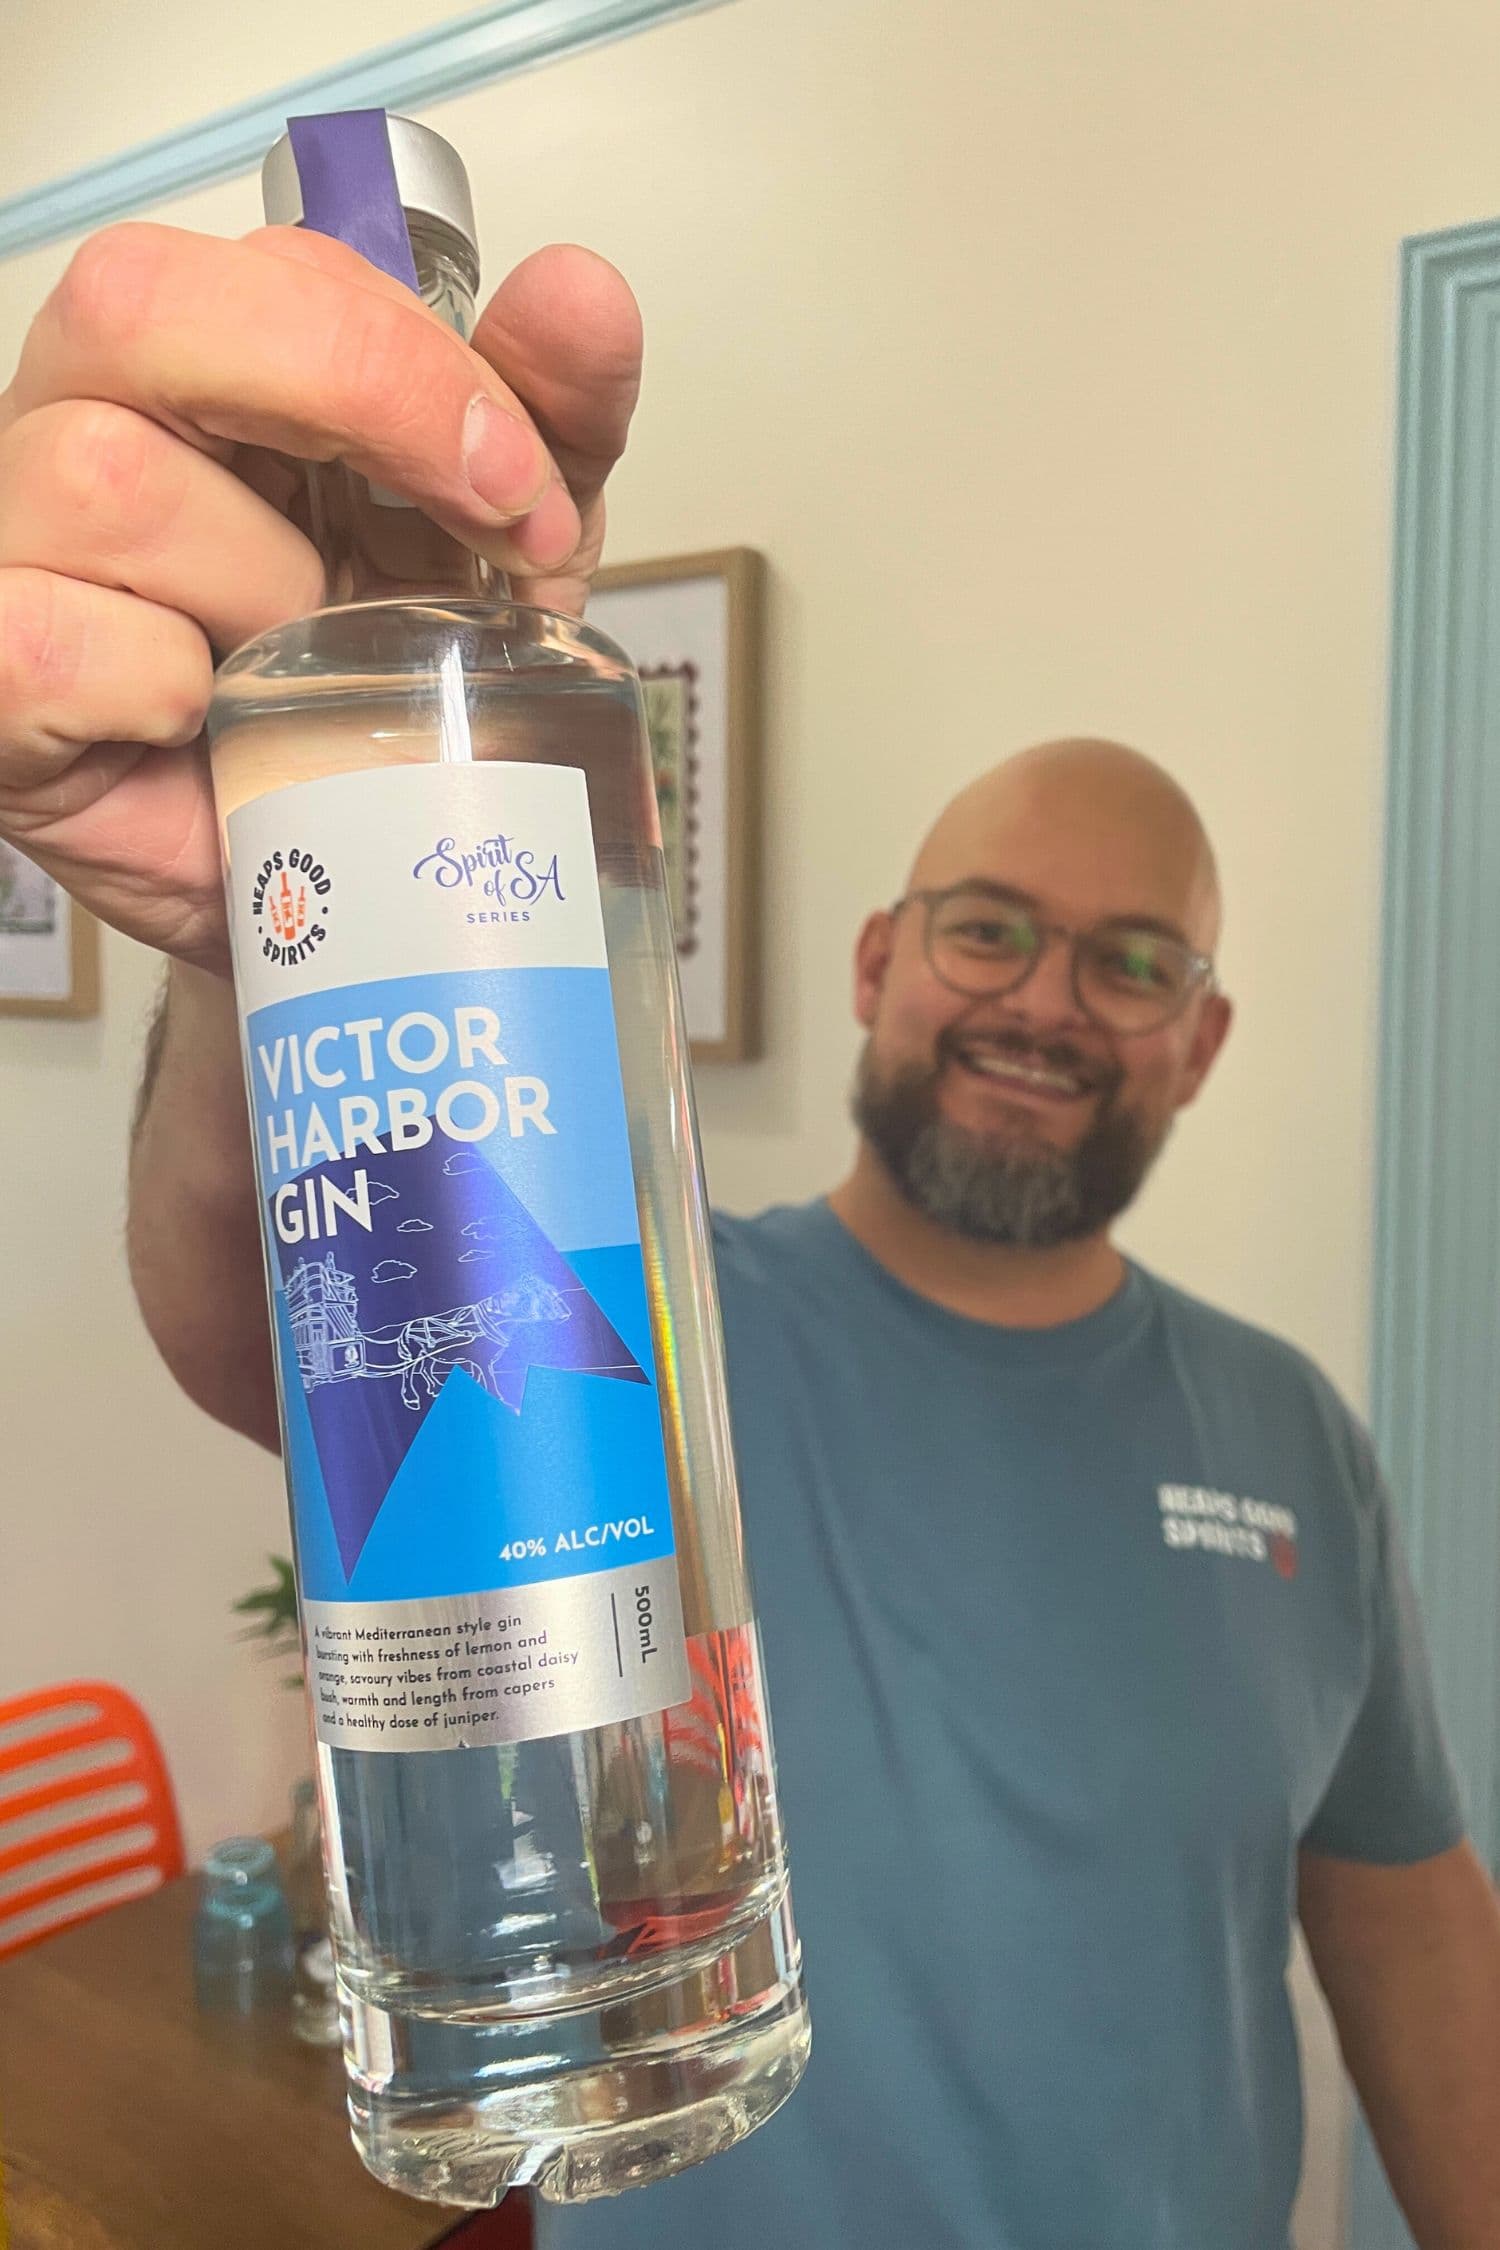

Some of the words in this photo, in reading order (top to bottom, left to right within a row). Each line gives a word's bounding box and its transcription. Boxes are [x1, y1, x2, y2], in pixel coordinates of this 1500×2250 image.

[253, 851, 283, 915] HEAPS
[289, 848, 331, 895] GOOD
[413, 834, 515, 888] Spirit
[484, 870, 506, 907] of
[510, 851, 567, 906] SA
[467, 911, 531, 924] SERIES
[263, 924, 326, 966] SPIRITS
[259, 1006, 511, 1102] VICTOR
[266, 1076, 558, 1175] HARBOR
[275, 1169, 373, 1244] GIN
[499, 1537, 548, 1561] 40%
[555, 1515, 655, 1553] ALC/VOL
[321, 1626, 352, 1641] vibrant
[355, 1626, 451, 1641] Mediterranean
[456, 1617, 492, 1636] style
[497, 1615, 522, 1632] gin
[351, 1648, 374, 1663] with
[377, 1647, 440, 1663] freshness
[445, 1642, 460, 1659] of
[465, 1640, 512, 1656] lemon
[517, 1629, 548, 1648] and
[635, 1585, 658, 1664] 500mL
[350, 1674, 392, 1688] savoury
[397, 1669, 431, 1684] vibes
[437, 1666, 472, 1681] from
[477, 1655, 533, 1677] coastal
[537, 1651, 579, 1669] daisy
[342, 1692, 379, 1706] warmth
[383, 1691, 407, 1707] and
[411, 1688, 457, 1707] length
[462, 1686, 499, 1701] from
[503, 1679, 555, 1696] capers
[346, 1713, 385, 1732] healthy
[389, 1714, 419, 1729] dose
[423, 1712, 438, 1727] of
[443, 1710, 500, 1729] juniper.
